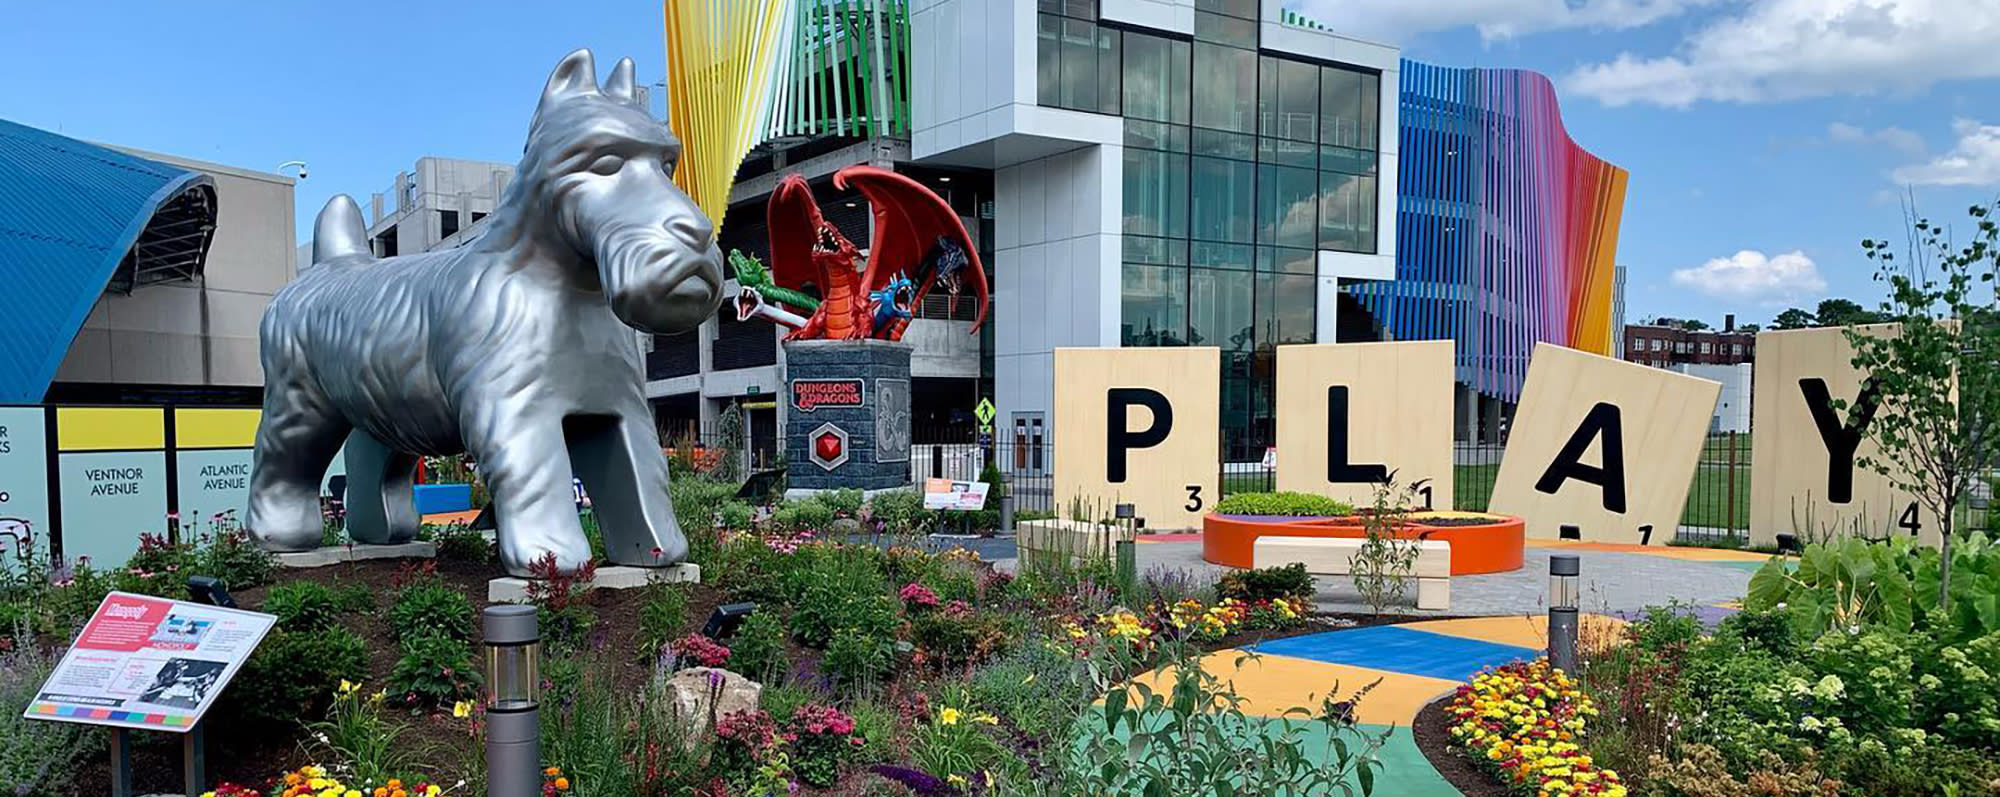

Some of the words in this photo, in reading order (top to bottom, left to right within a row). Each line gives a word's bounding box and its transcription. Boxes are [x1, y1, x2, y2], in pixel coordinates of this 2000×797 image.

[795, 383, 857, 393] DUNGEONS
[809, 393, 861, 403] DRAGONS
[1107, 387, 1173, 483] P
[1327, 385, 1387, 483] L
[1798, 377, 1884, 503] Y
[1535, 402, 1627, 514] A
[85, 467, 144, 481] VENTNOR
[200, 464, 249, 477] ATLANTIC
[91, 482, 140, 496] AVENUE
[204, 477, 245, 490] AVENUE
[1185, 485, 1202, 512] 3
[1419, 486, 1432, 510] 1
[1899, 501, 1922, 535] 4
[1637, 524, 1653, 545] 1
